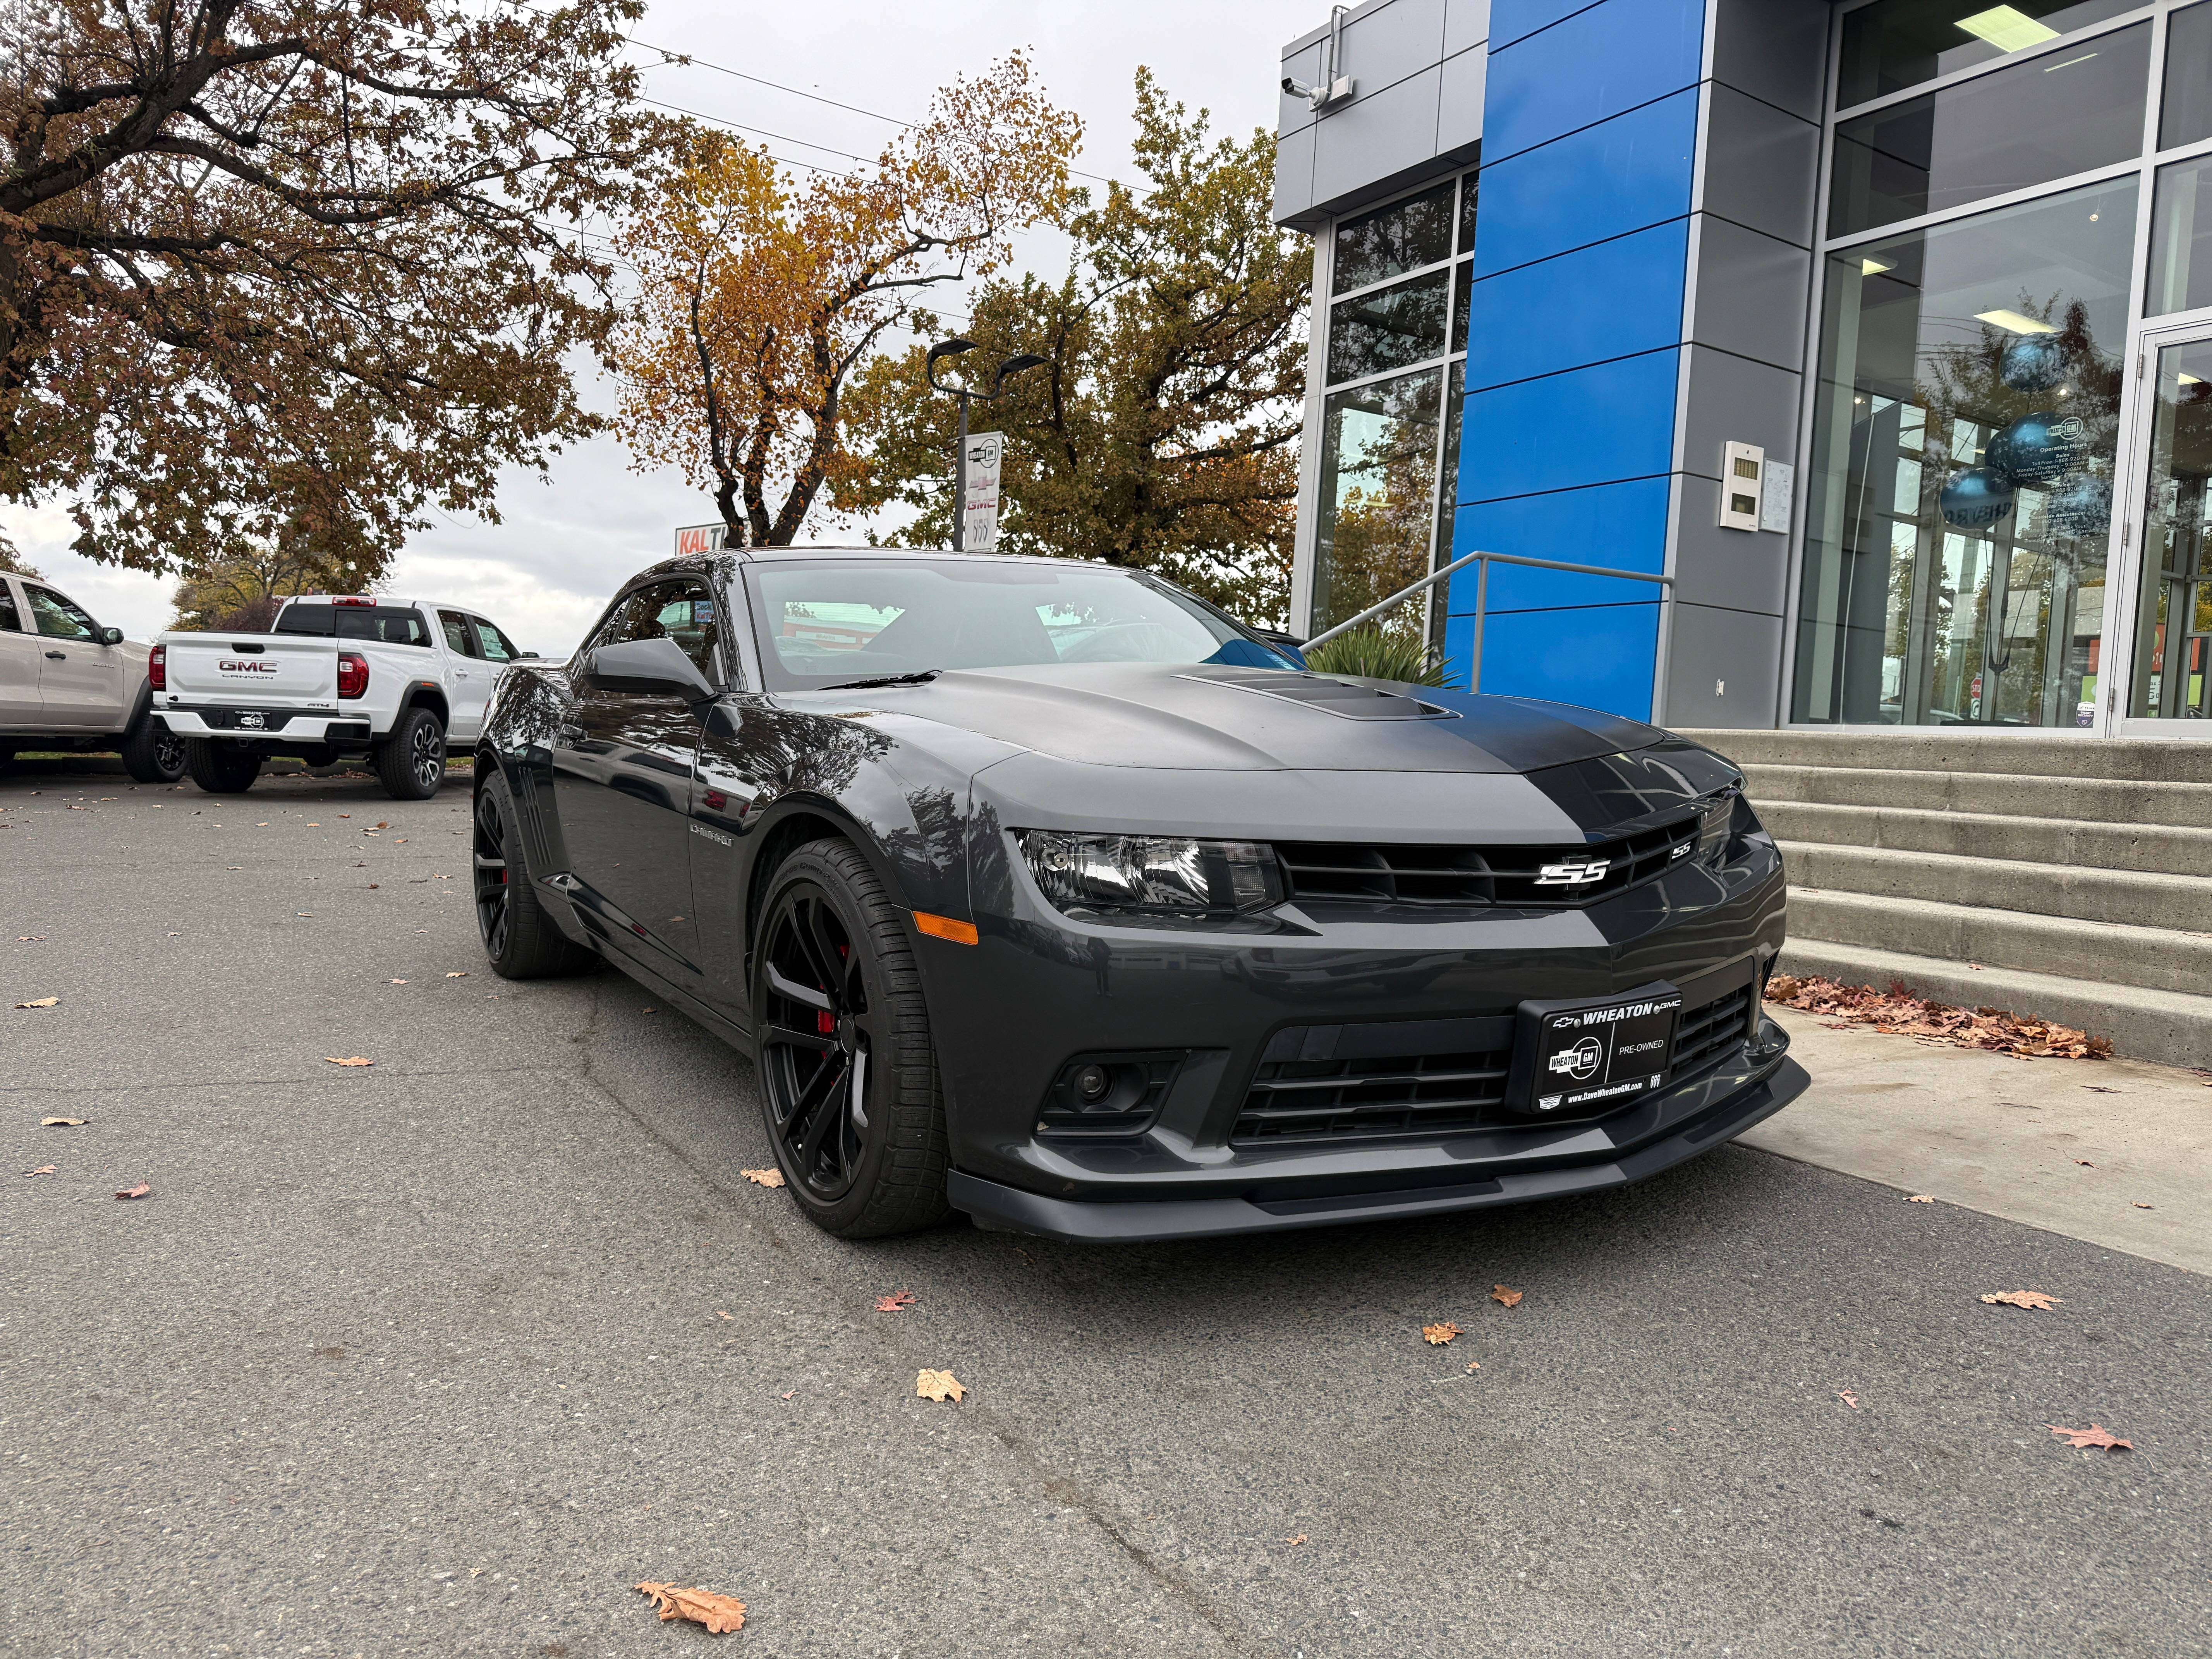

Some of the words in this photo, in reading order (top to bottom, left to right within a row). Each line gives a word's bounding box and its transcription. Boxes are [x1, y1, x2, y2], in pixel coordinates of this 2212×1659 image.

[2047, 426, 2065, 434] WHEATON
[2016, 464, 2060, 472] Monday-Thursday
[967, 497, 996, 510] GMC
[680, 529, 709, 555] KAL
[219, 661, 277, 673] GMC
[1671, 841, 1691, 859] SS
[1534, 859, 1611, 885] SS
[1660, 1000, 1681, 1009] GMC
[1583, 1002, 1653, 1025] WHEATON
[1619, 1039, 1663, 1056] PRE-OWNED
[1551, 1052, 1578, 1068] WHEATON
[1583, 1051, 1594, 1062] GM
[1568, 1082, 1643, 1104] www.DaveWheatonGM.com
